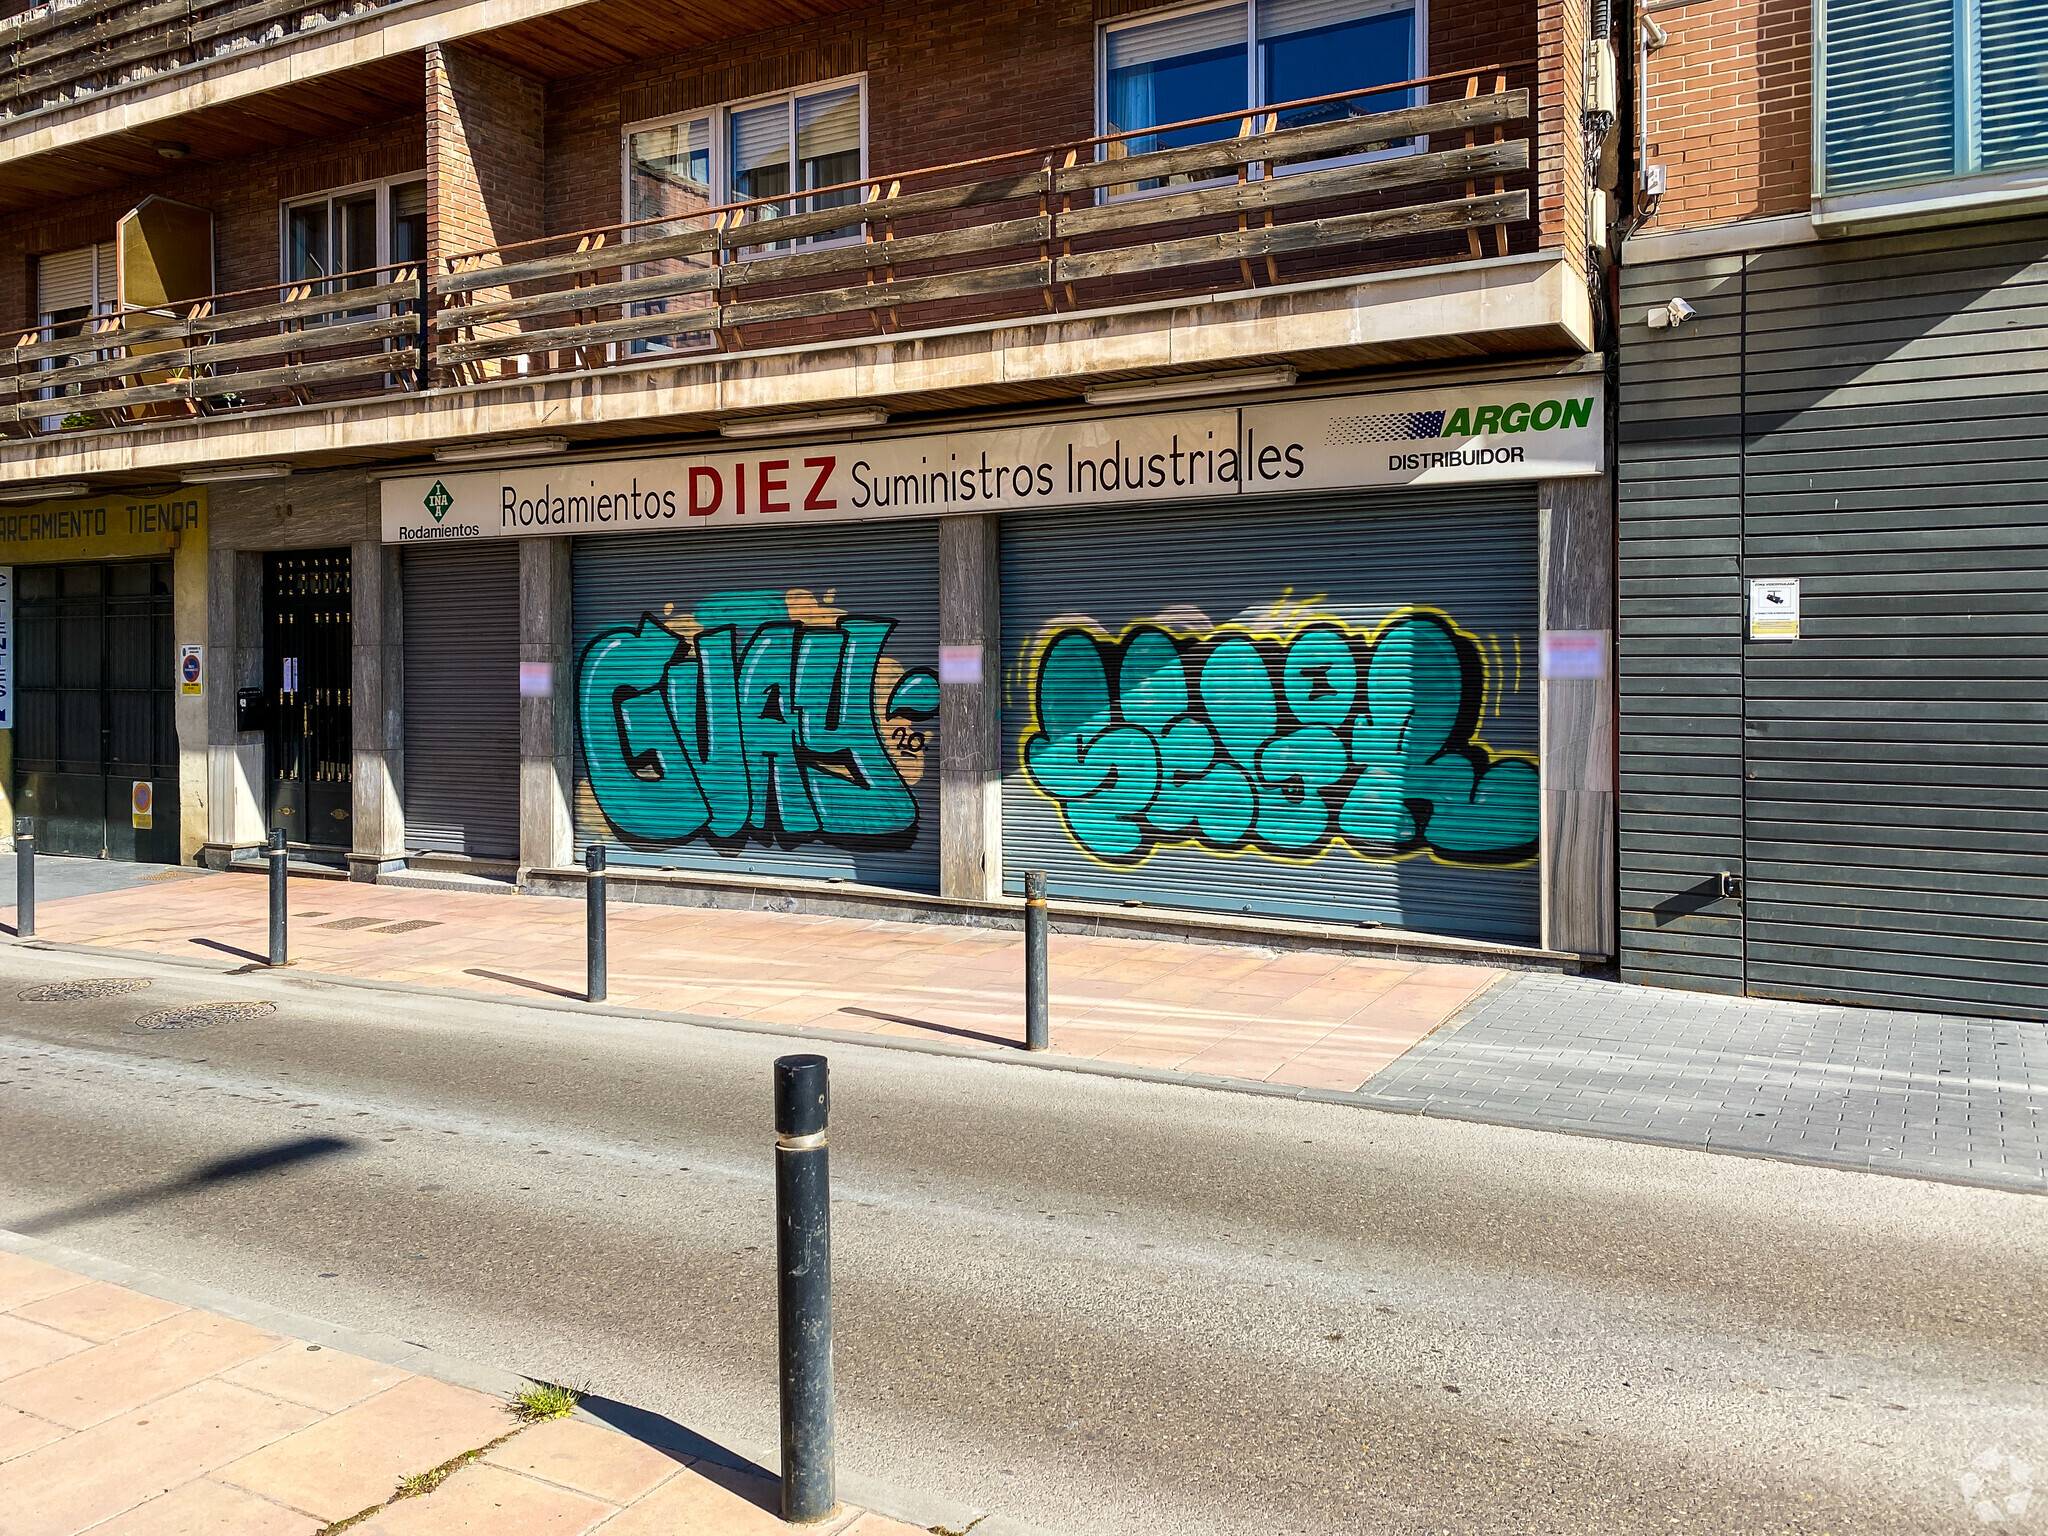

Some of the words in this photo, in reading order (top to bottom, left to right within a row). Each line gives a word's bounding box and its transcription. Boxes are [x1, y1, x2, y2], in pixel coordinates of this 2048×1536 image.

[1441, 397, 1594, 438] ARGON
[1389, 446, 1524, 471] DISTRIBUIDOR
[501, 478, 676, 527] Rodamientos
[688, 456, 838, 517] DIEZ
[851, 451, 1054, 508] Suministros
[1067, 428, 1305, 493] Industriales
[126, 501, 198, 534] TIENDA
[399, 524, 480, 540] Rodamientos
